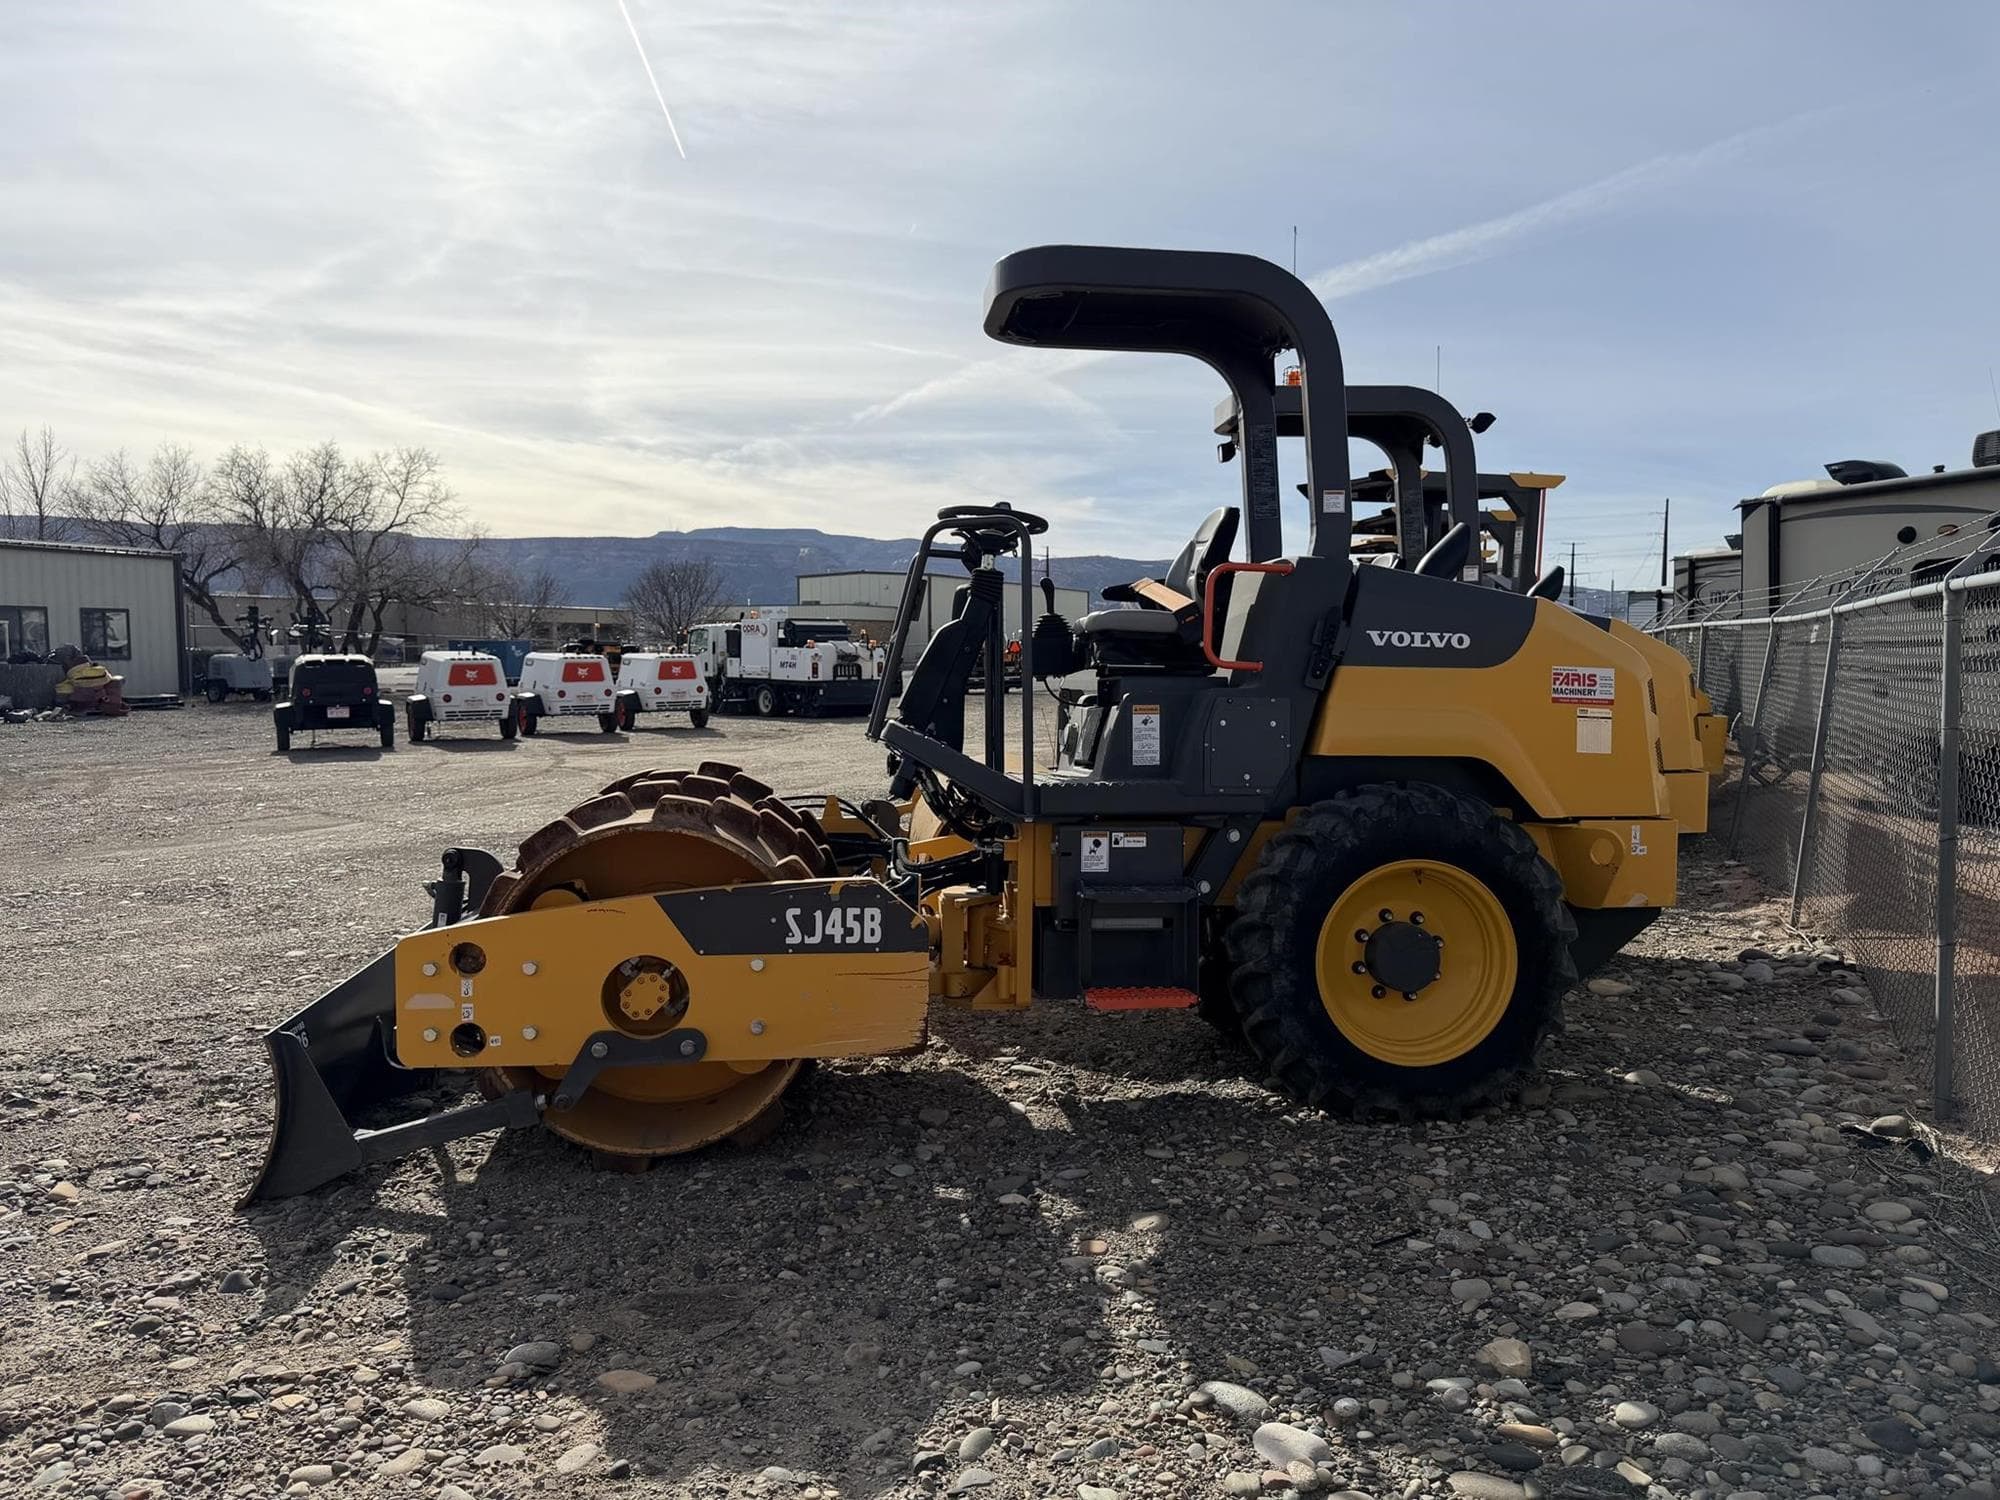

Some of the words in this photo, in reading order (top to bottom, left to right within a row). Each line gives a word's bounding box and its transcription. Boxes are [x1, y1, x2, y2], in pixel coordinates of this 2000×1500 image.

[1366, 630, 1471, 649] VOLVO
[1552, 672, 1597, 687] FARIS
[1552, 688, 1597, 696] MACHINERY
[785, 907, 882, 944] SJ45B
